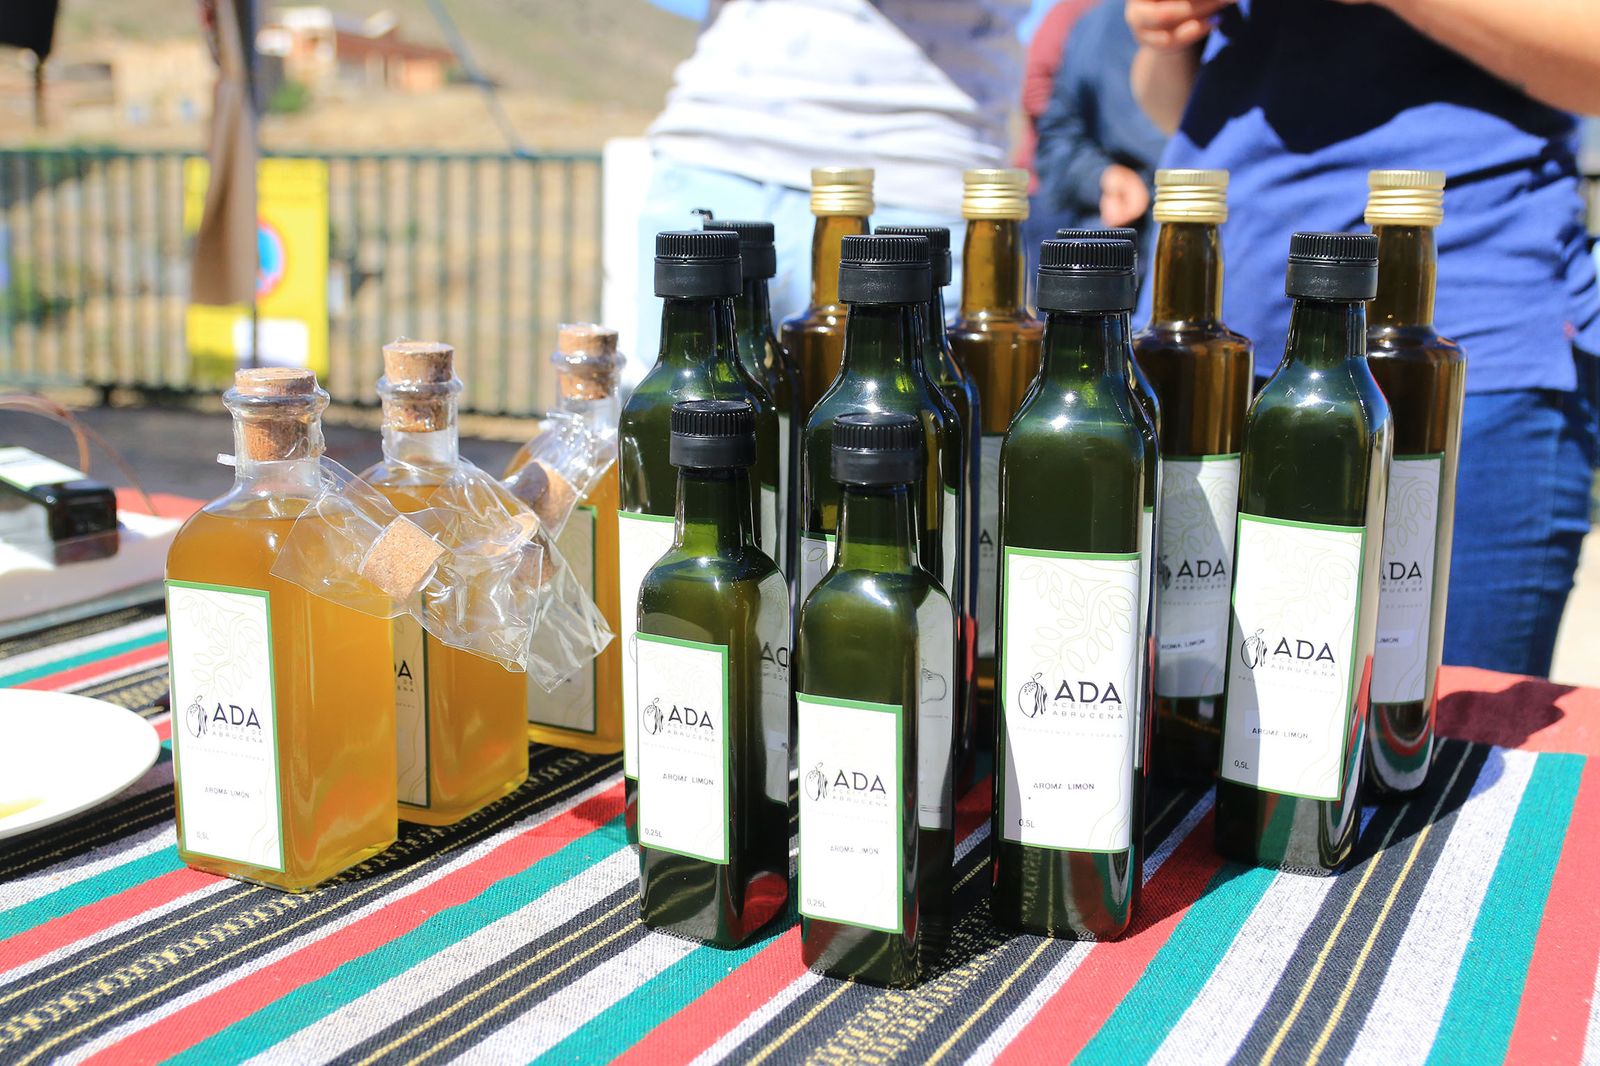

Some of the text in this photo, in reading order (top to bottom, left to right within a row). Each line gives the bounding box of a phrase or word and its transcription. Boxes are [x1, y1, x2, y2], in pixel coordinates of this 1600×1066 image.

[1177, 559, 1226, 578] ADA
[1382, 561, 1422, 580] DA
[1273, 636, 1335, 663] ADA
[1054, 680, 1122, 704] ADA
[213, 702, 261, 730] ADA
[668, 705, 714, 731] ADA
[1052, 702, 1098, 711] ACEITE
[1052, 710, 1124, 720] ABRUCENA
[833, 769, 887, 795] ADA
